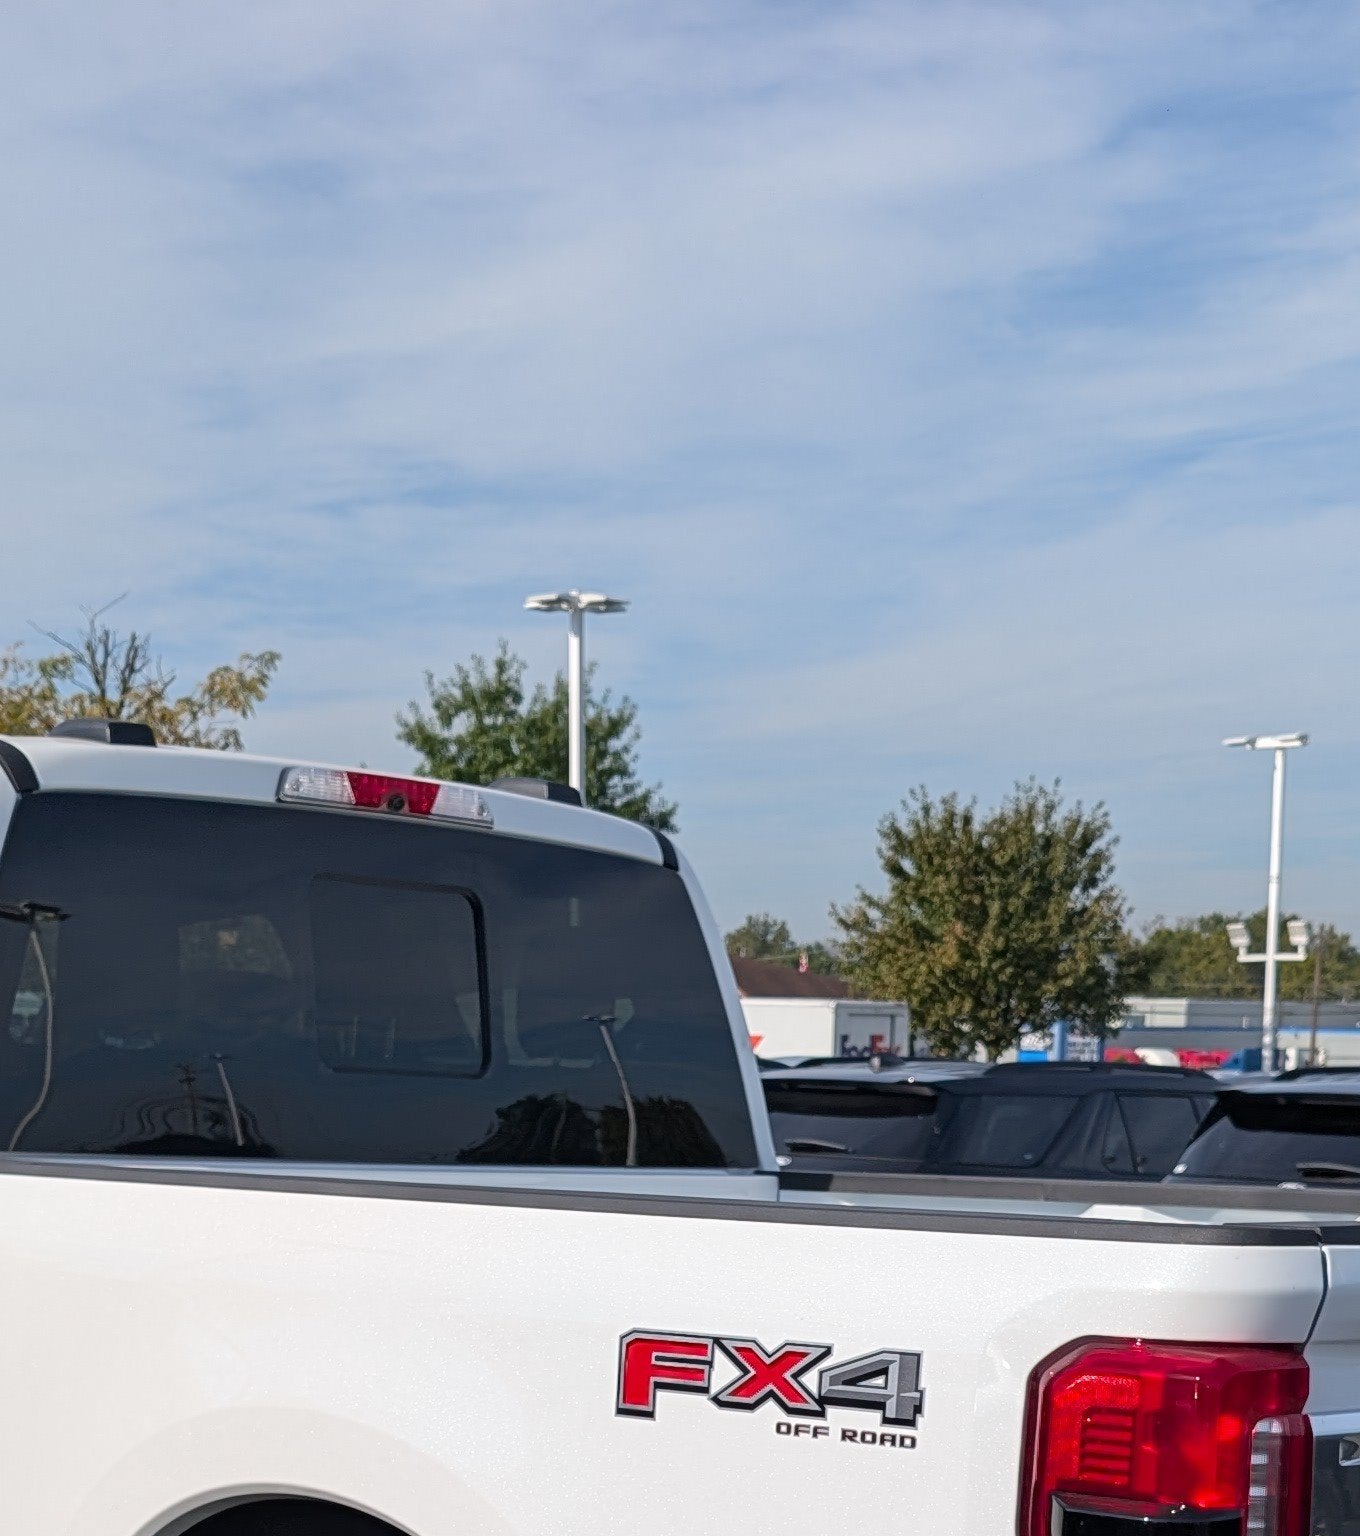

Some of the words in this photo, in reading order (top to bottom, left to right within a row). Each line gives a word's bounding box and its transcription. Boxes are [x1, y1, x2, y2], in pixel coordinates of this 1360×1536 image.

[614, 1328, 926, 1428] FX4
[775, 1420, 830, 1440] OFF
[839, 1426, 918, 1450] ROAD
